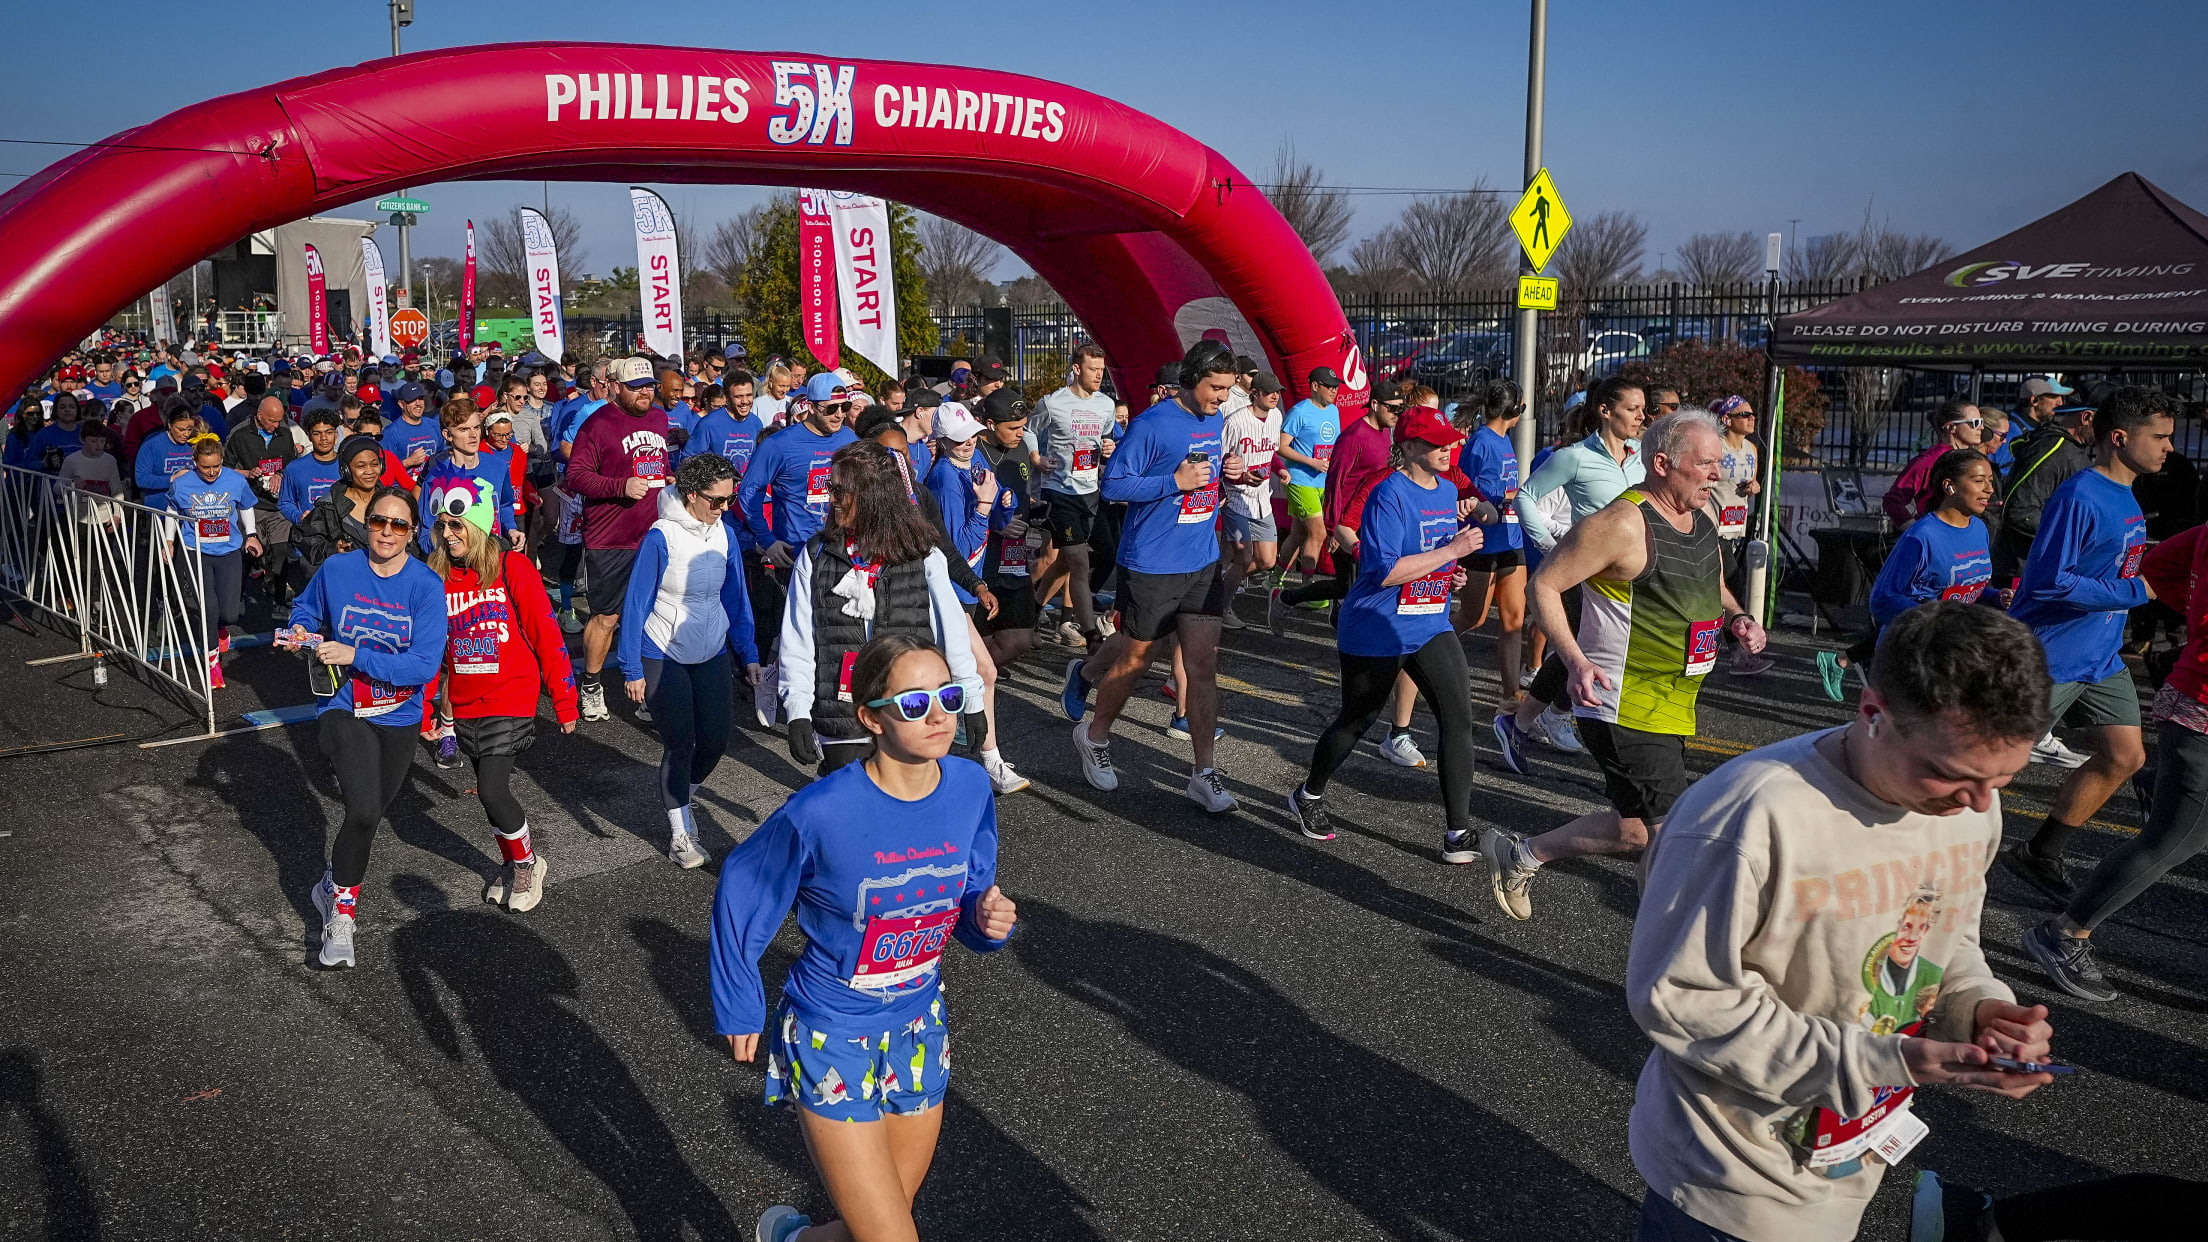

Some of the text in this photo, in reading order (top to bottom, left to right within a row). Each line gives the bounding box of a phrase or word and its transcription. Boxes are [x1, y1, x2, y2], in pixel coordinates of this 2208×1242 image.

[545, 60, 1067, 146] PHILLIES 5K CHARITIES
[380, 201, 405, 211] CITIZENS
[406, 202, 421, 211] BANK
[632, 195, 676, 234] 5K
[522, 214, 556, 249] 5K
[850, 227, 881, 330] START
[651, 255, 673, 334] START
[813, 235, 823, 345] 6:00-8:00 MILE
[1524, 285, 1553, 301] AHEAD
[1899, 296, 1959, 304] EVENT
[1961, 293, 2027, 301] TIMING
[2050, 288, 2208, 301] MANAGEMENT
[536, 268, 557, 338] START
[314, 322, 323, 347] MILE
[392, 320, 426, 336] STOP
[1793, 321, 2206, 336] PLEASE DO NOT DISTURB TIMING DURING
[1810, 343, 1857, 356] Find
[1860, 343, 1935, 357] results
[1941, 342, 1966, 355] at
[1336, 393, 1353, 402] OUR
[1240, 437, 1277, 455] Phillie
[203, 523, 224, 534] 356
[1410, 580, 1443, 597] 1916
[454, 637, 494, 657] 3340
[874, 841, 959, 864] Phillies Charities, Inc.
[872, 925, 946, 962] 6675
[894, 959, 914, 969] JULIA
[1861, 1104, 1887, 1130] JUSTIN
